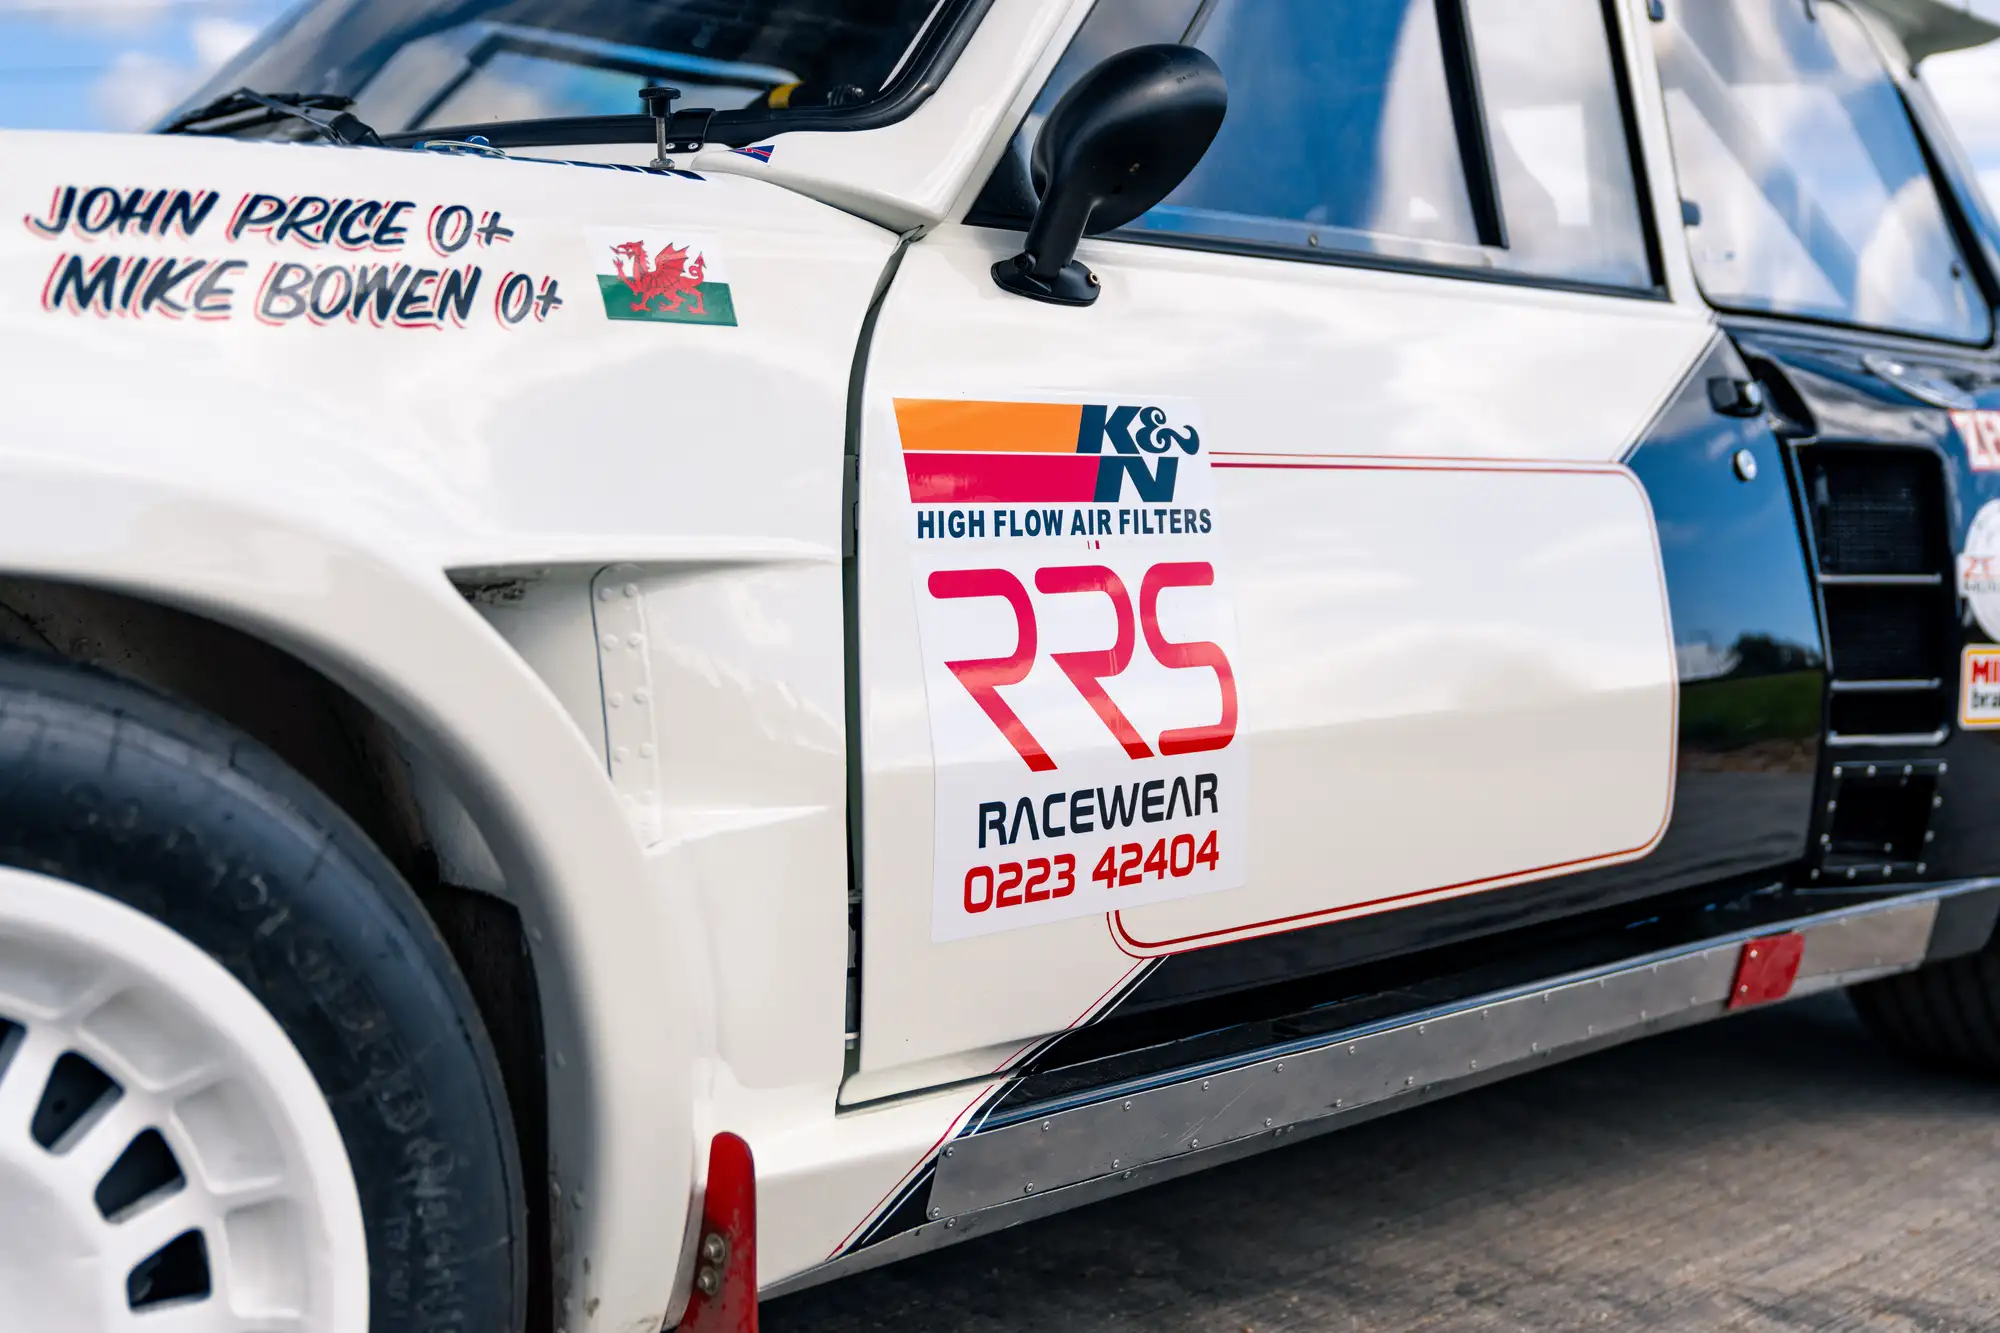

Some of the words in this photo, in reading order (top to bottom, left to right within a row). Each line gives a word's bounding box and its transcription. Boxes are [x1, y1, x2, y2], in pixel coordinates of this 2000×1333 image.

[24, 186, 219, 244] JOHN
[225, 192, 416, 253] PRICE
[42, 252, 247, 321] MIKE
[255, 265, 481, 330] BOWEN
[917, 509, 985, 539] HIGH
[993, 509, 1064, 538] FLOW
[1070, 509, 1112, 536] AIR
[1118, 508, 1212, 535] FILTERS
[928, 562, 1238, 772] RRS
[978, 773, 1219, 849] RACEWEAR
[964, 853, 1077, 915] 0223
[1092, 830, 1220, 889] 42404
